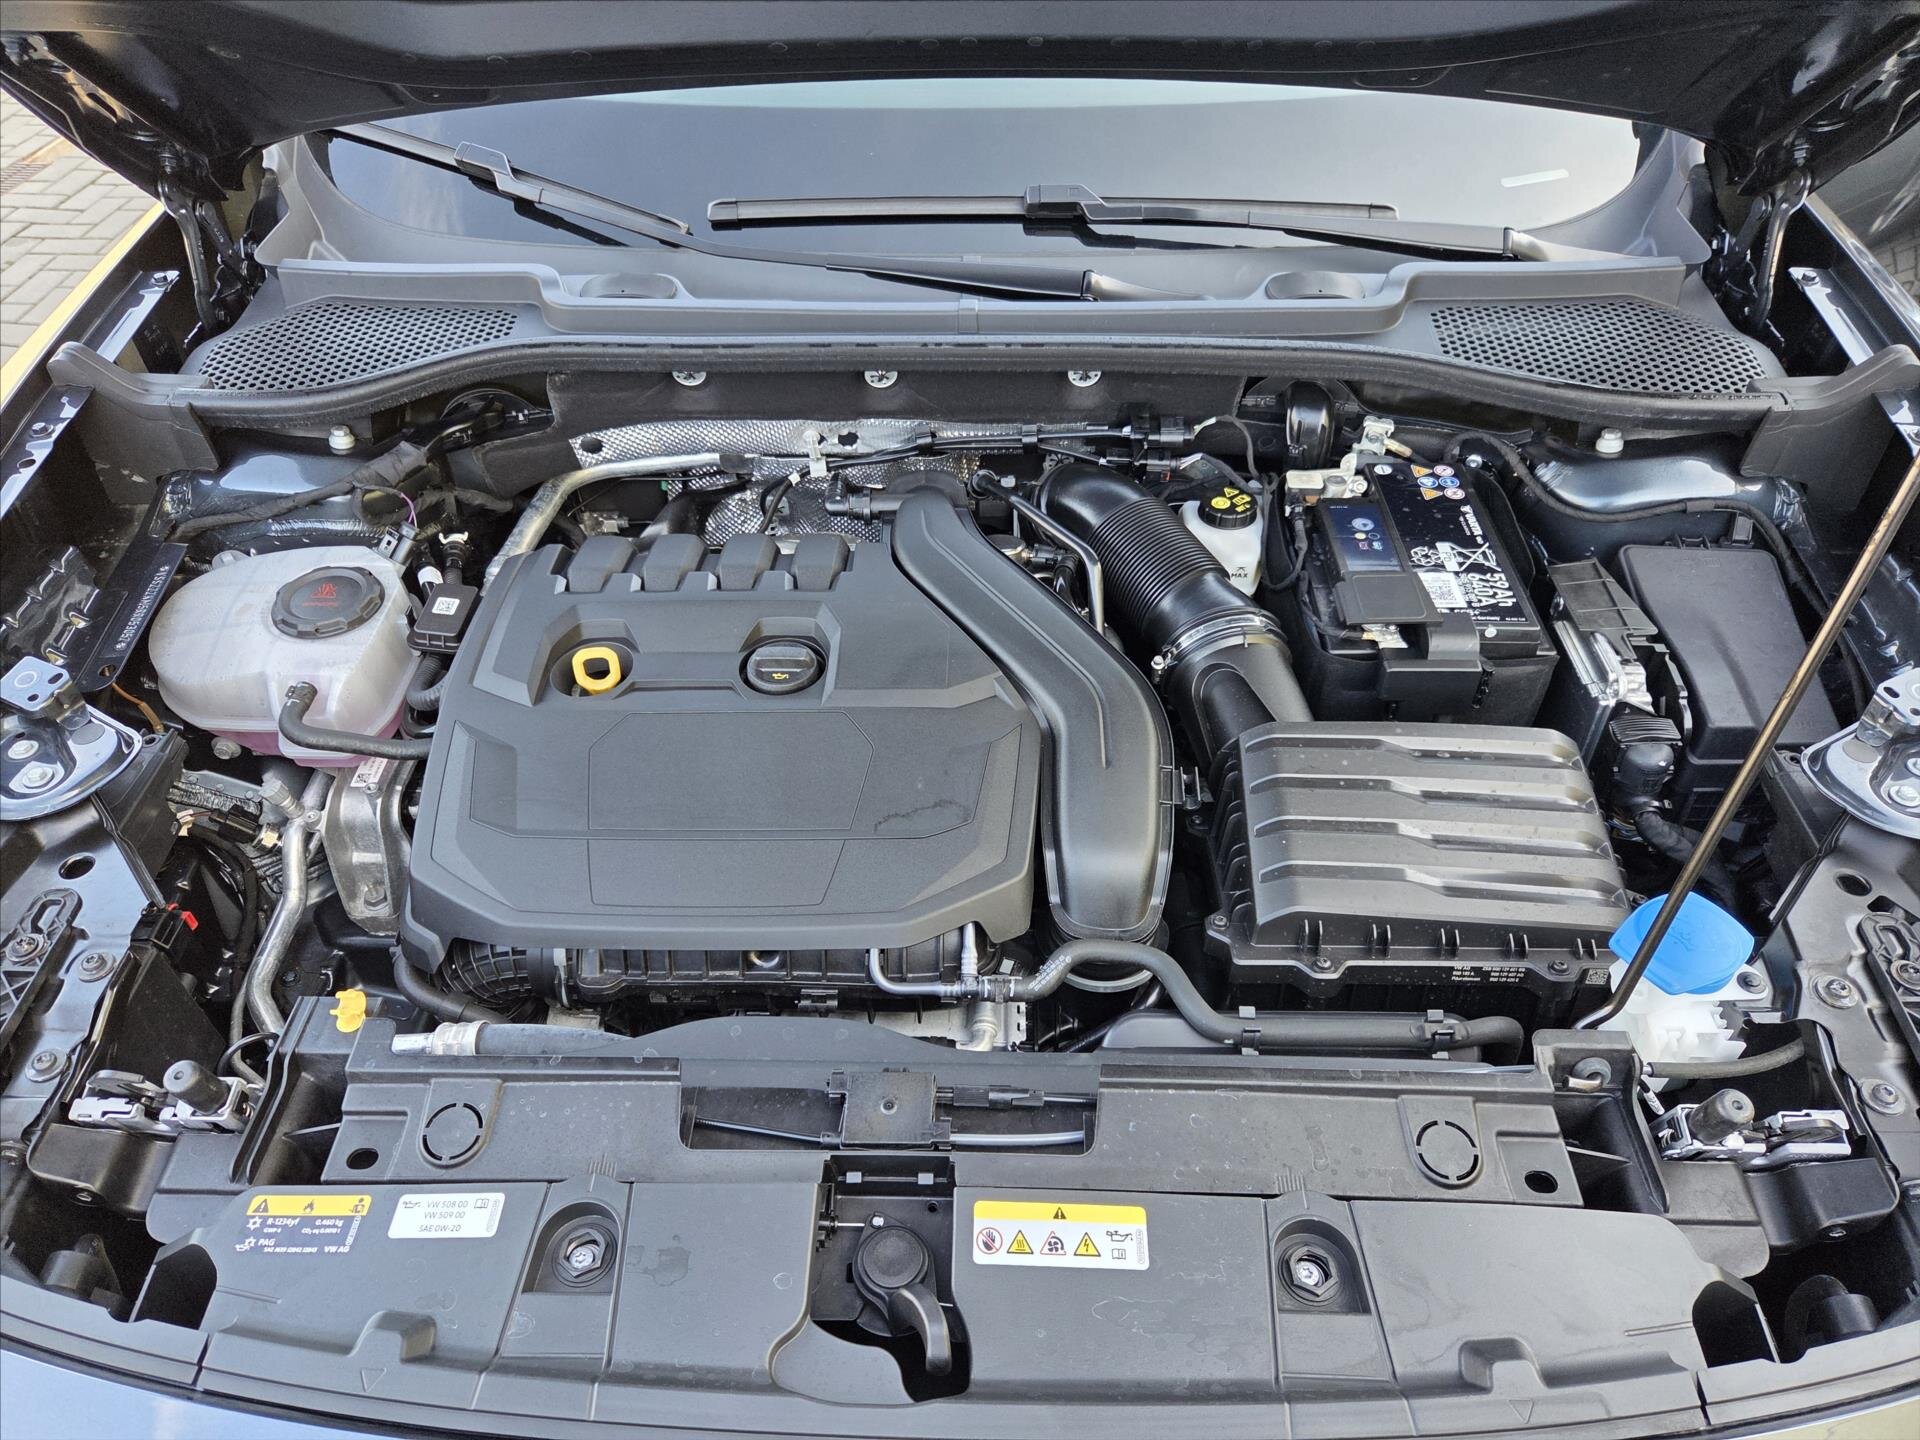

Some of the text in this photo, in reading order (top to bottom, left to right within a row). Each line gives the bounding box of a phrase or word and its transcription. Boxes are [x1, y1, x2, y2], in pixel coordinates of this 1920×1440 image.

[1467, 572, 1498, 607] 640A
[1486, 572, 1517, 607] 59Ah
[427, 1200, 469, 1208] VW 508 00
[424, 1211, 466, 1219] VW 509 00
[266, 1217, 301, 1228] R-1234yf
[418, 1224, 434, 1232] SAE
[258, 1238, 276, 1246] PAG
[324, 1245, 338, 1253] VW
[337, 1245, 350, 1253] AG
